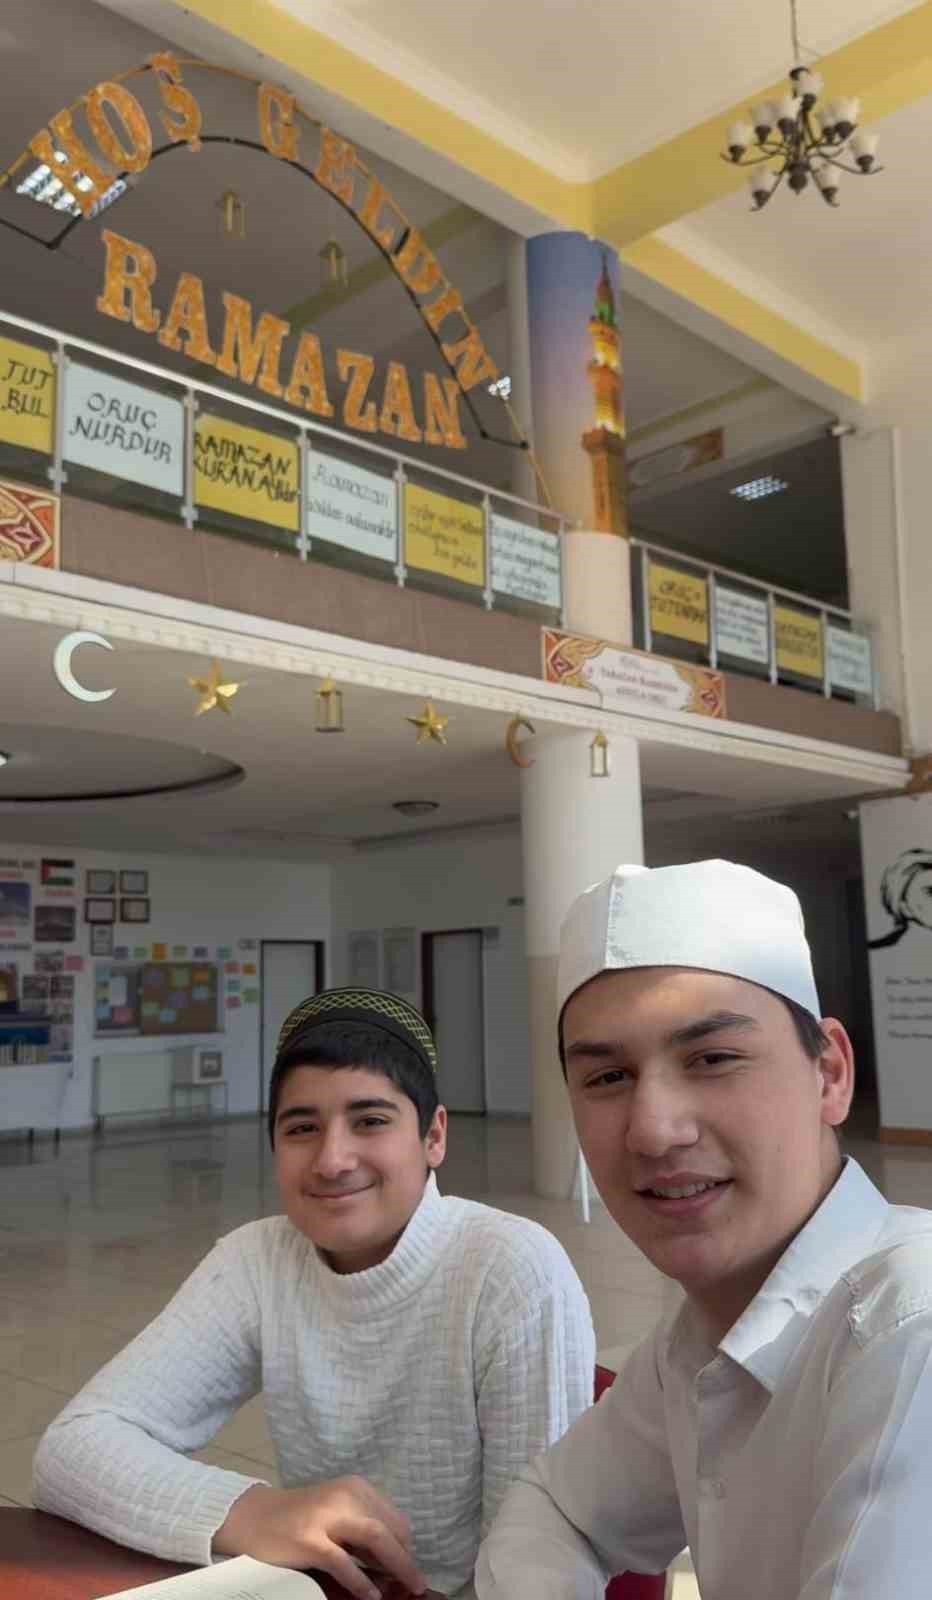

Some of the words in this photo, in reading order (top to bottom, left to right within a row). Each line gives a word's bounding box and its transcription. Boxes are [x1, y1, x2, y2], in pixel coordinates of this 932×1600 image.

[97, 229, 467, 449] RAMAZAN
[2, 359, 54, 390] TUT
[2, 387, 49, 418] BUL
[69, 416, 172, 464] NURDUR
